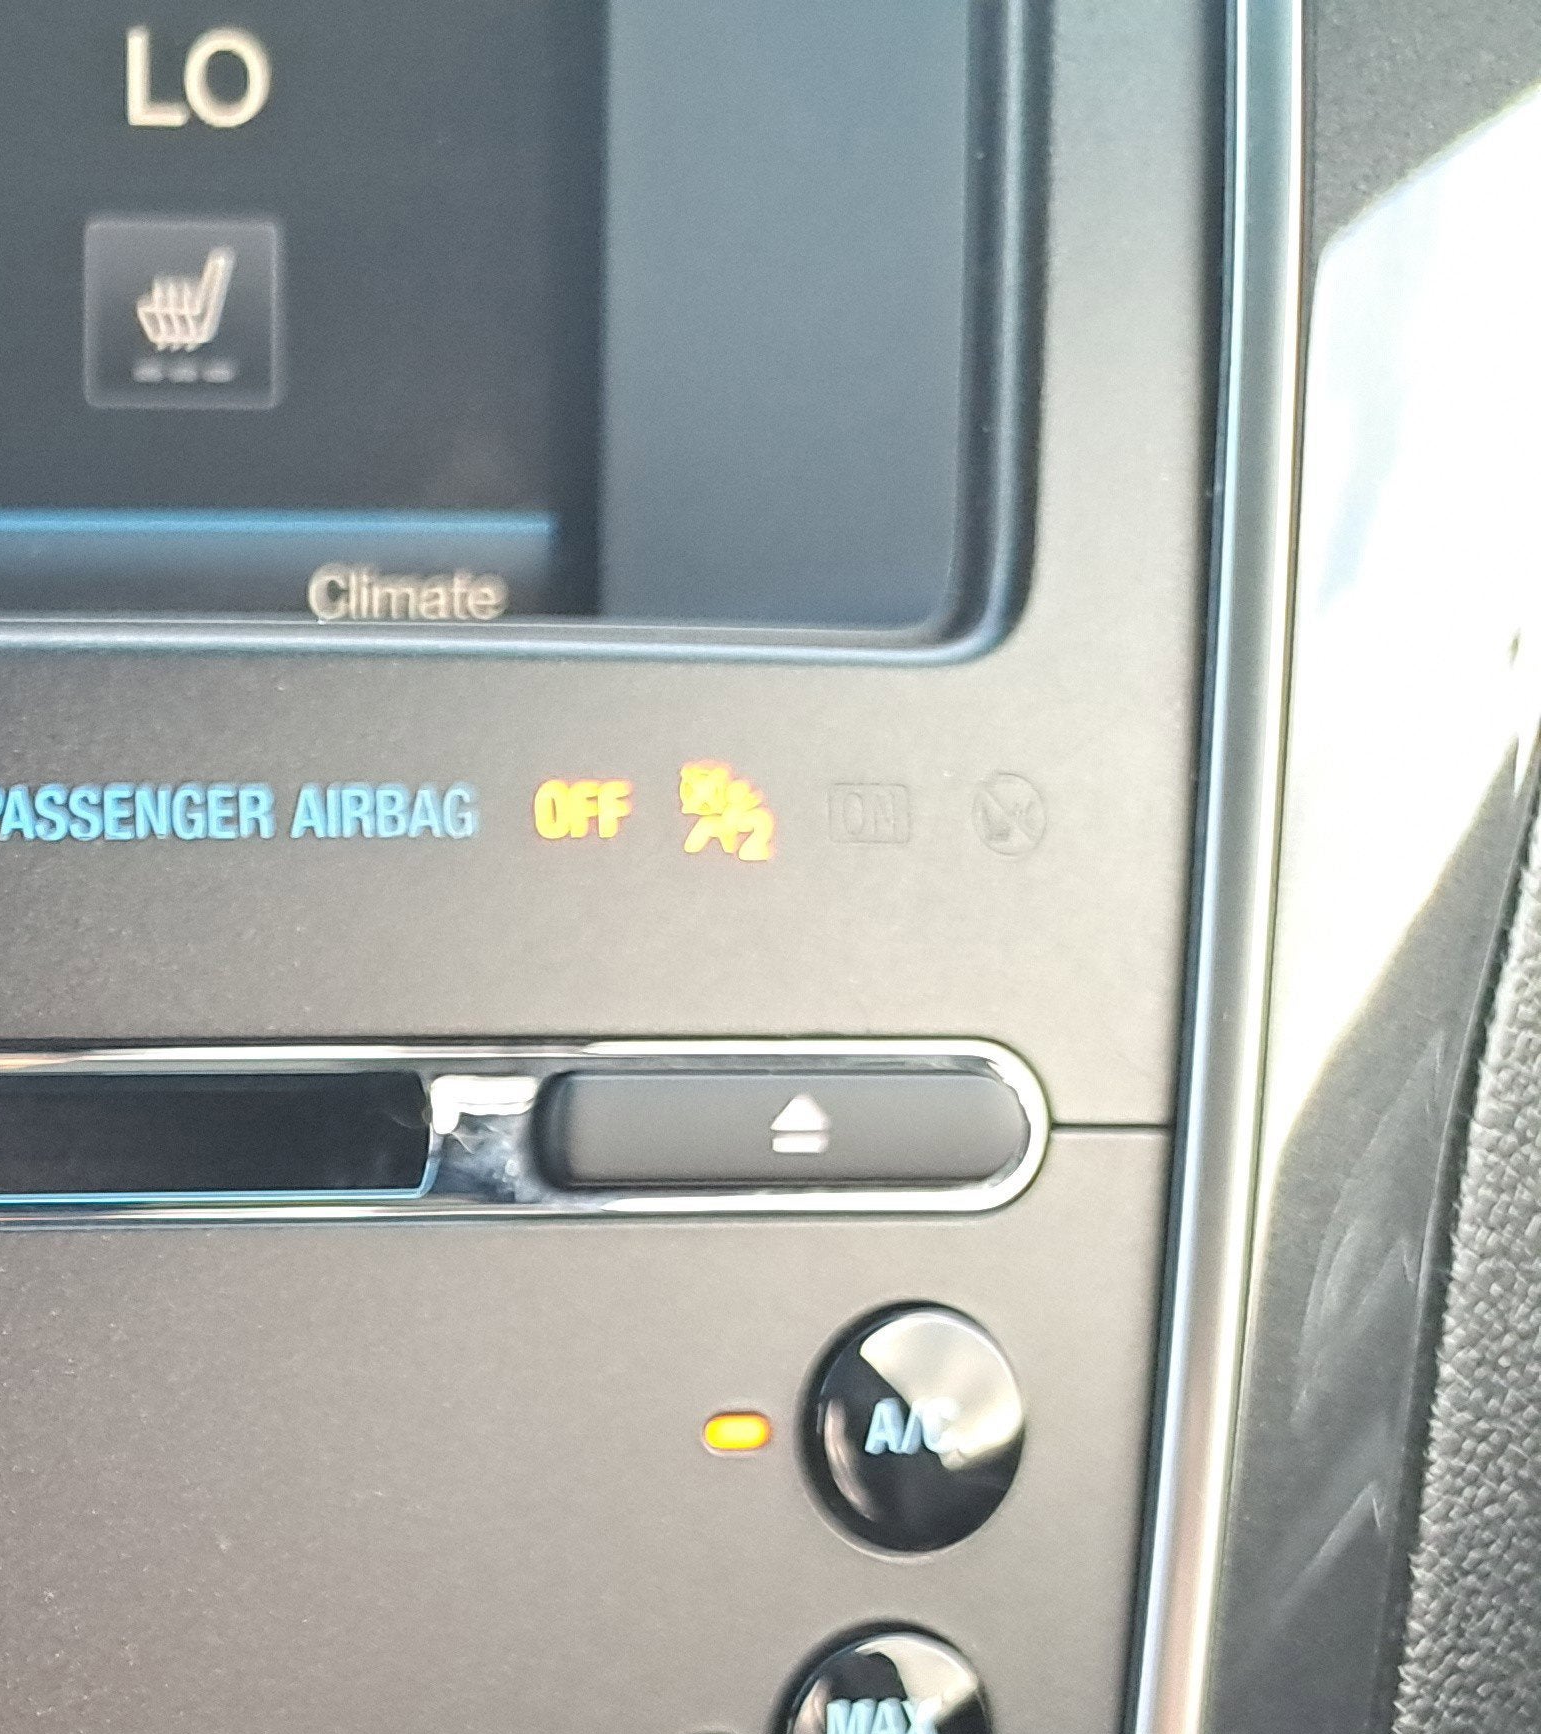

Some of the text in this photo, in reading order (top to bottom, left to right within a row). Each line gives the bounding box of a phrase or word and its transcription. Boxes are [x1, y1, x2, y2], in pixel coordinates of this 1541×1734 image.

[125, 26, 272, 129] LO
[309, 564, 508, 622] Climate
[290, 782, 479, 840] AIRBAG
[533, 778, 633, 840] OFF
